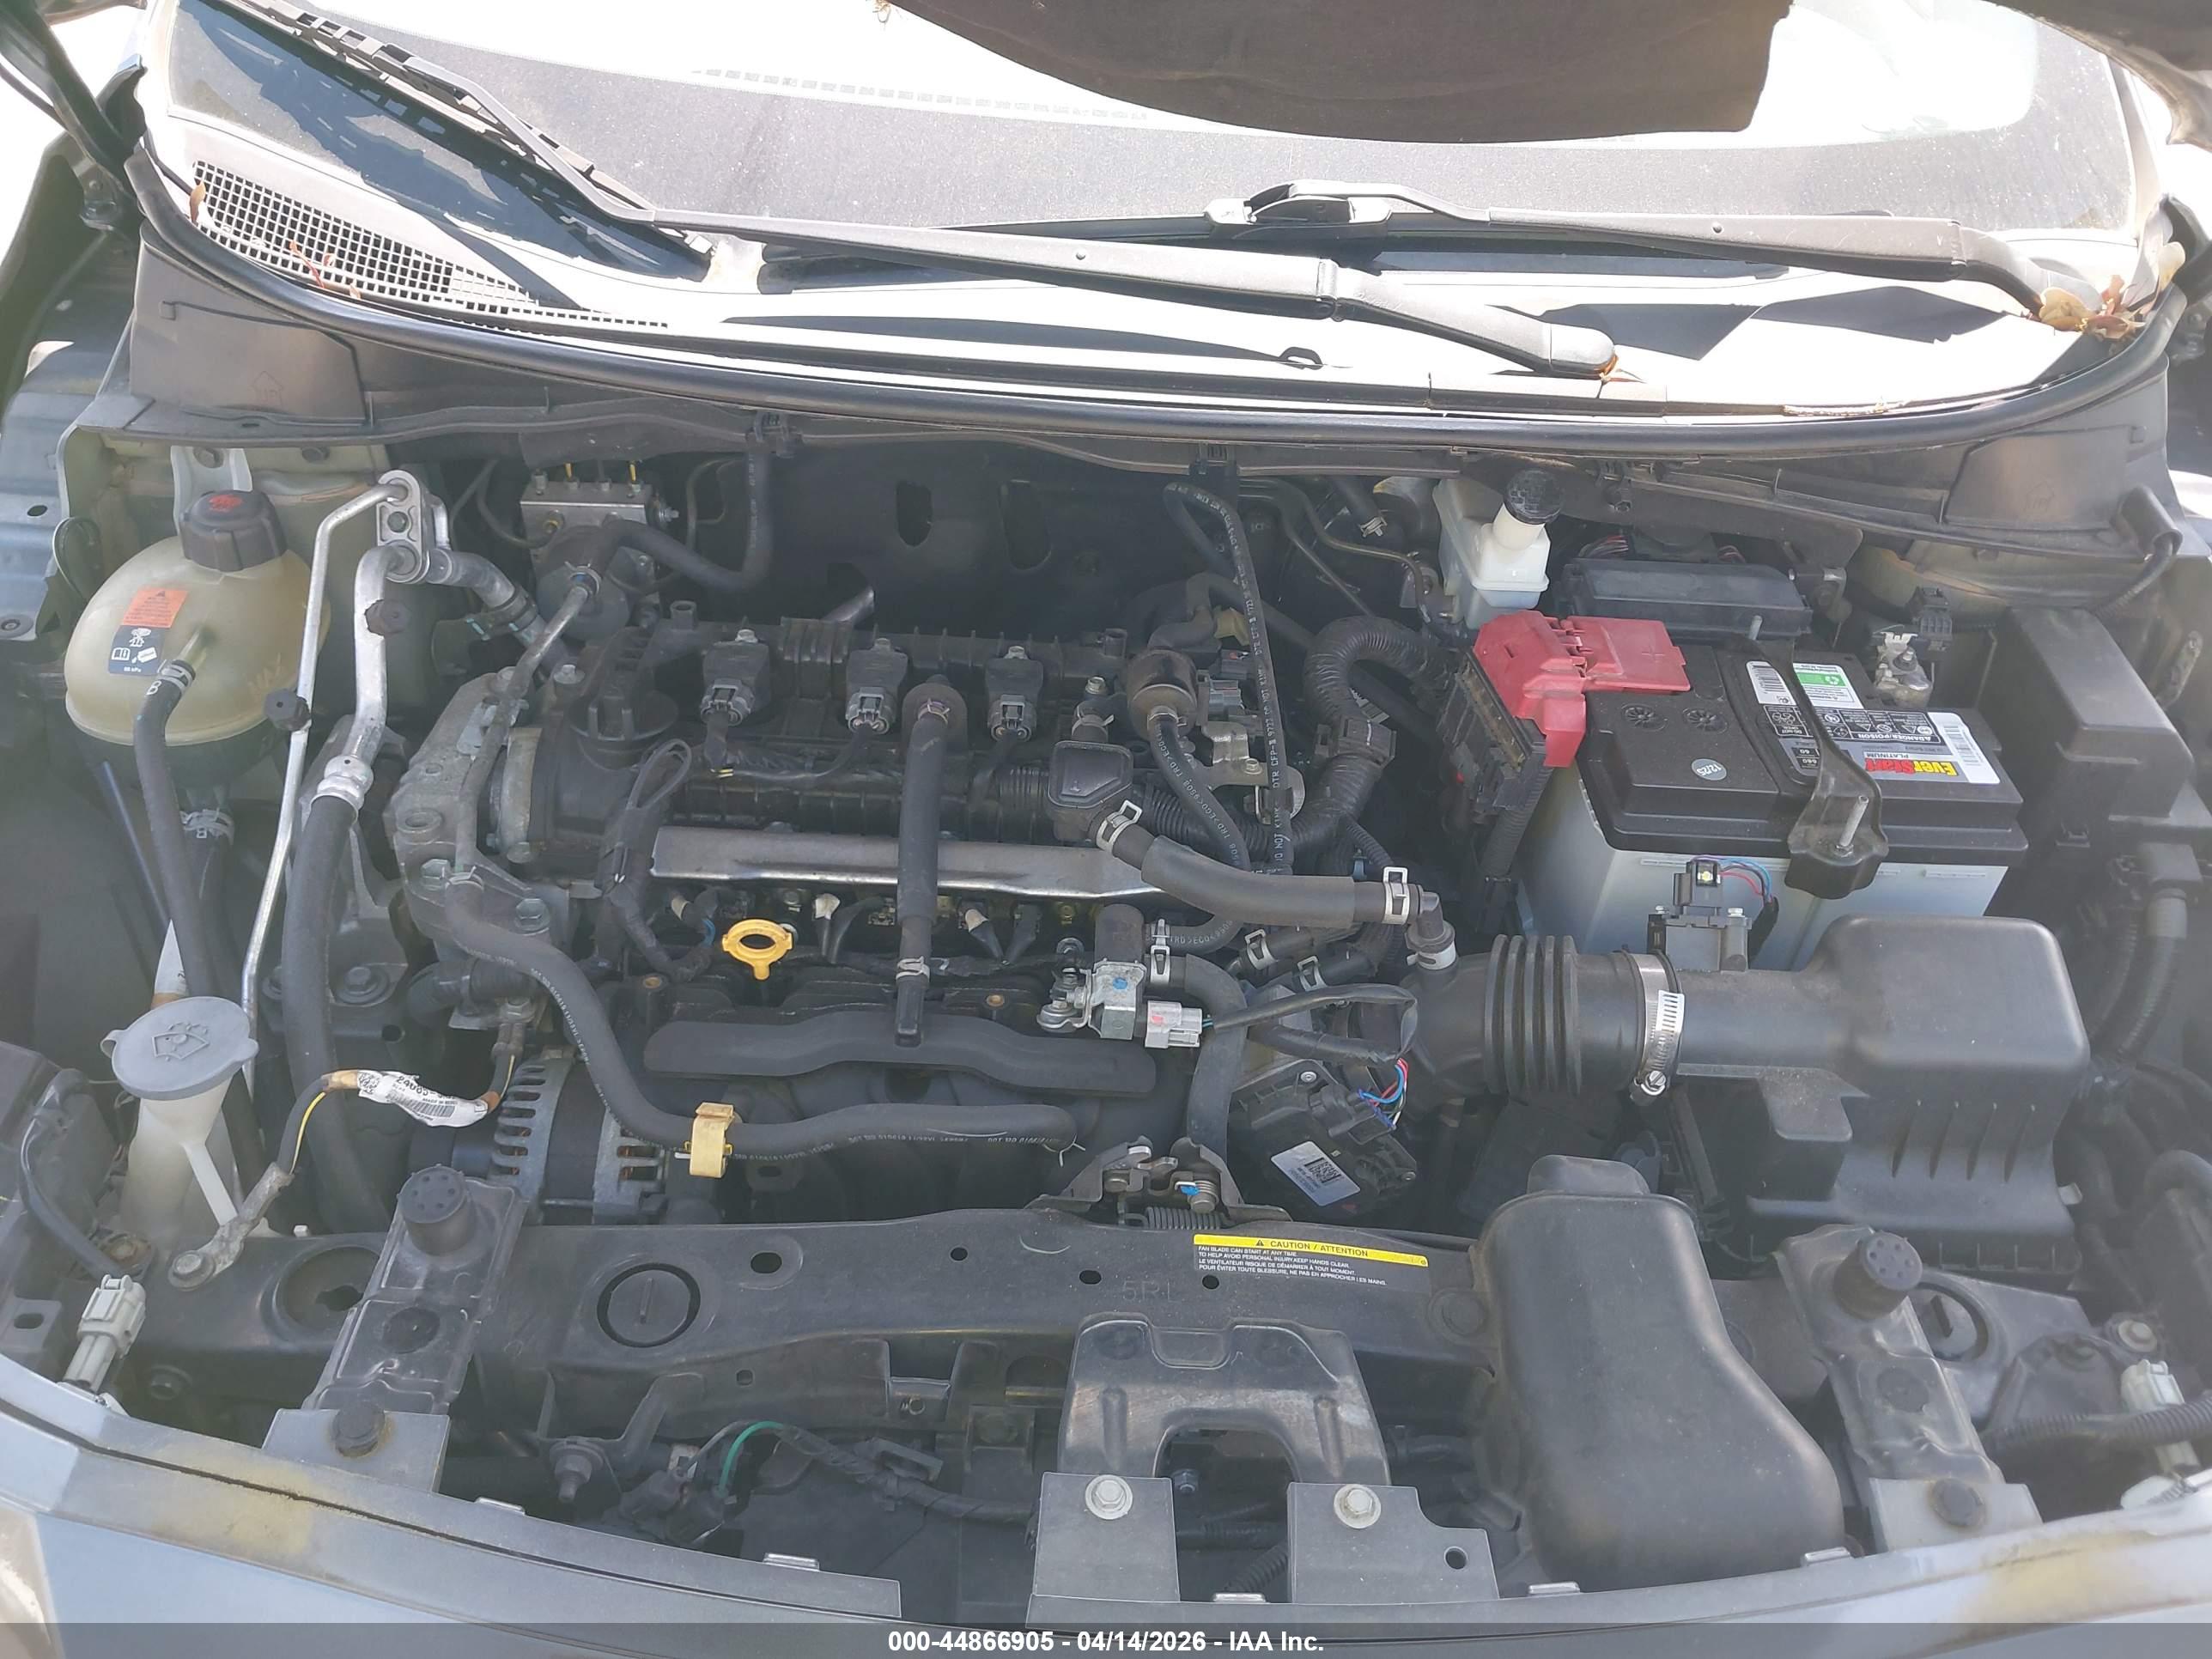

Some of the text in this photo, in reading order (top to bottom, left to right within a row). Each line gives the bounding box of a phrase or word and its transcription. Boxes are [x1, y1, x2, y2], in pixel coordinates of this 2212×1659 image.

[1865, 757, 1959, 776] EverStart
[1272, 770, 1280, 789] DTR
[1274, 833, 1284, 848] NOT
[1270, 1240, 1310, 1249] CAUTION
[1320, 1245, 1369, 1257] ATTENTION
[1321, 1273, 1356, 1281] APPROCHER
